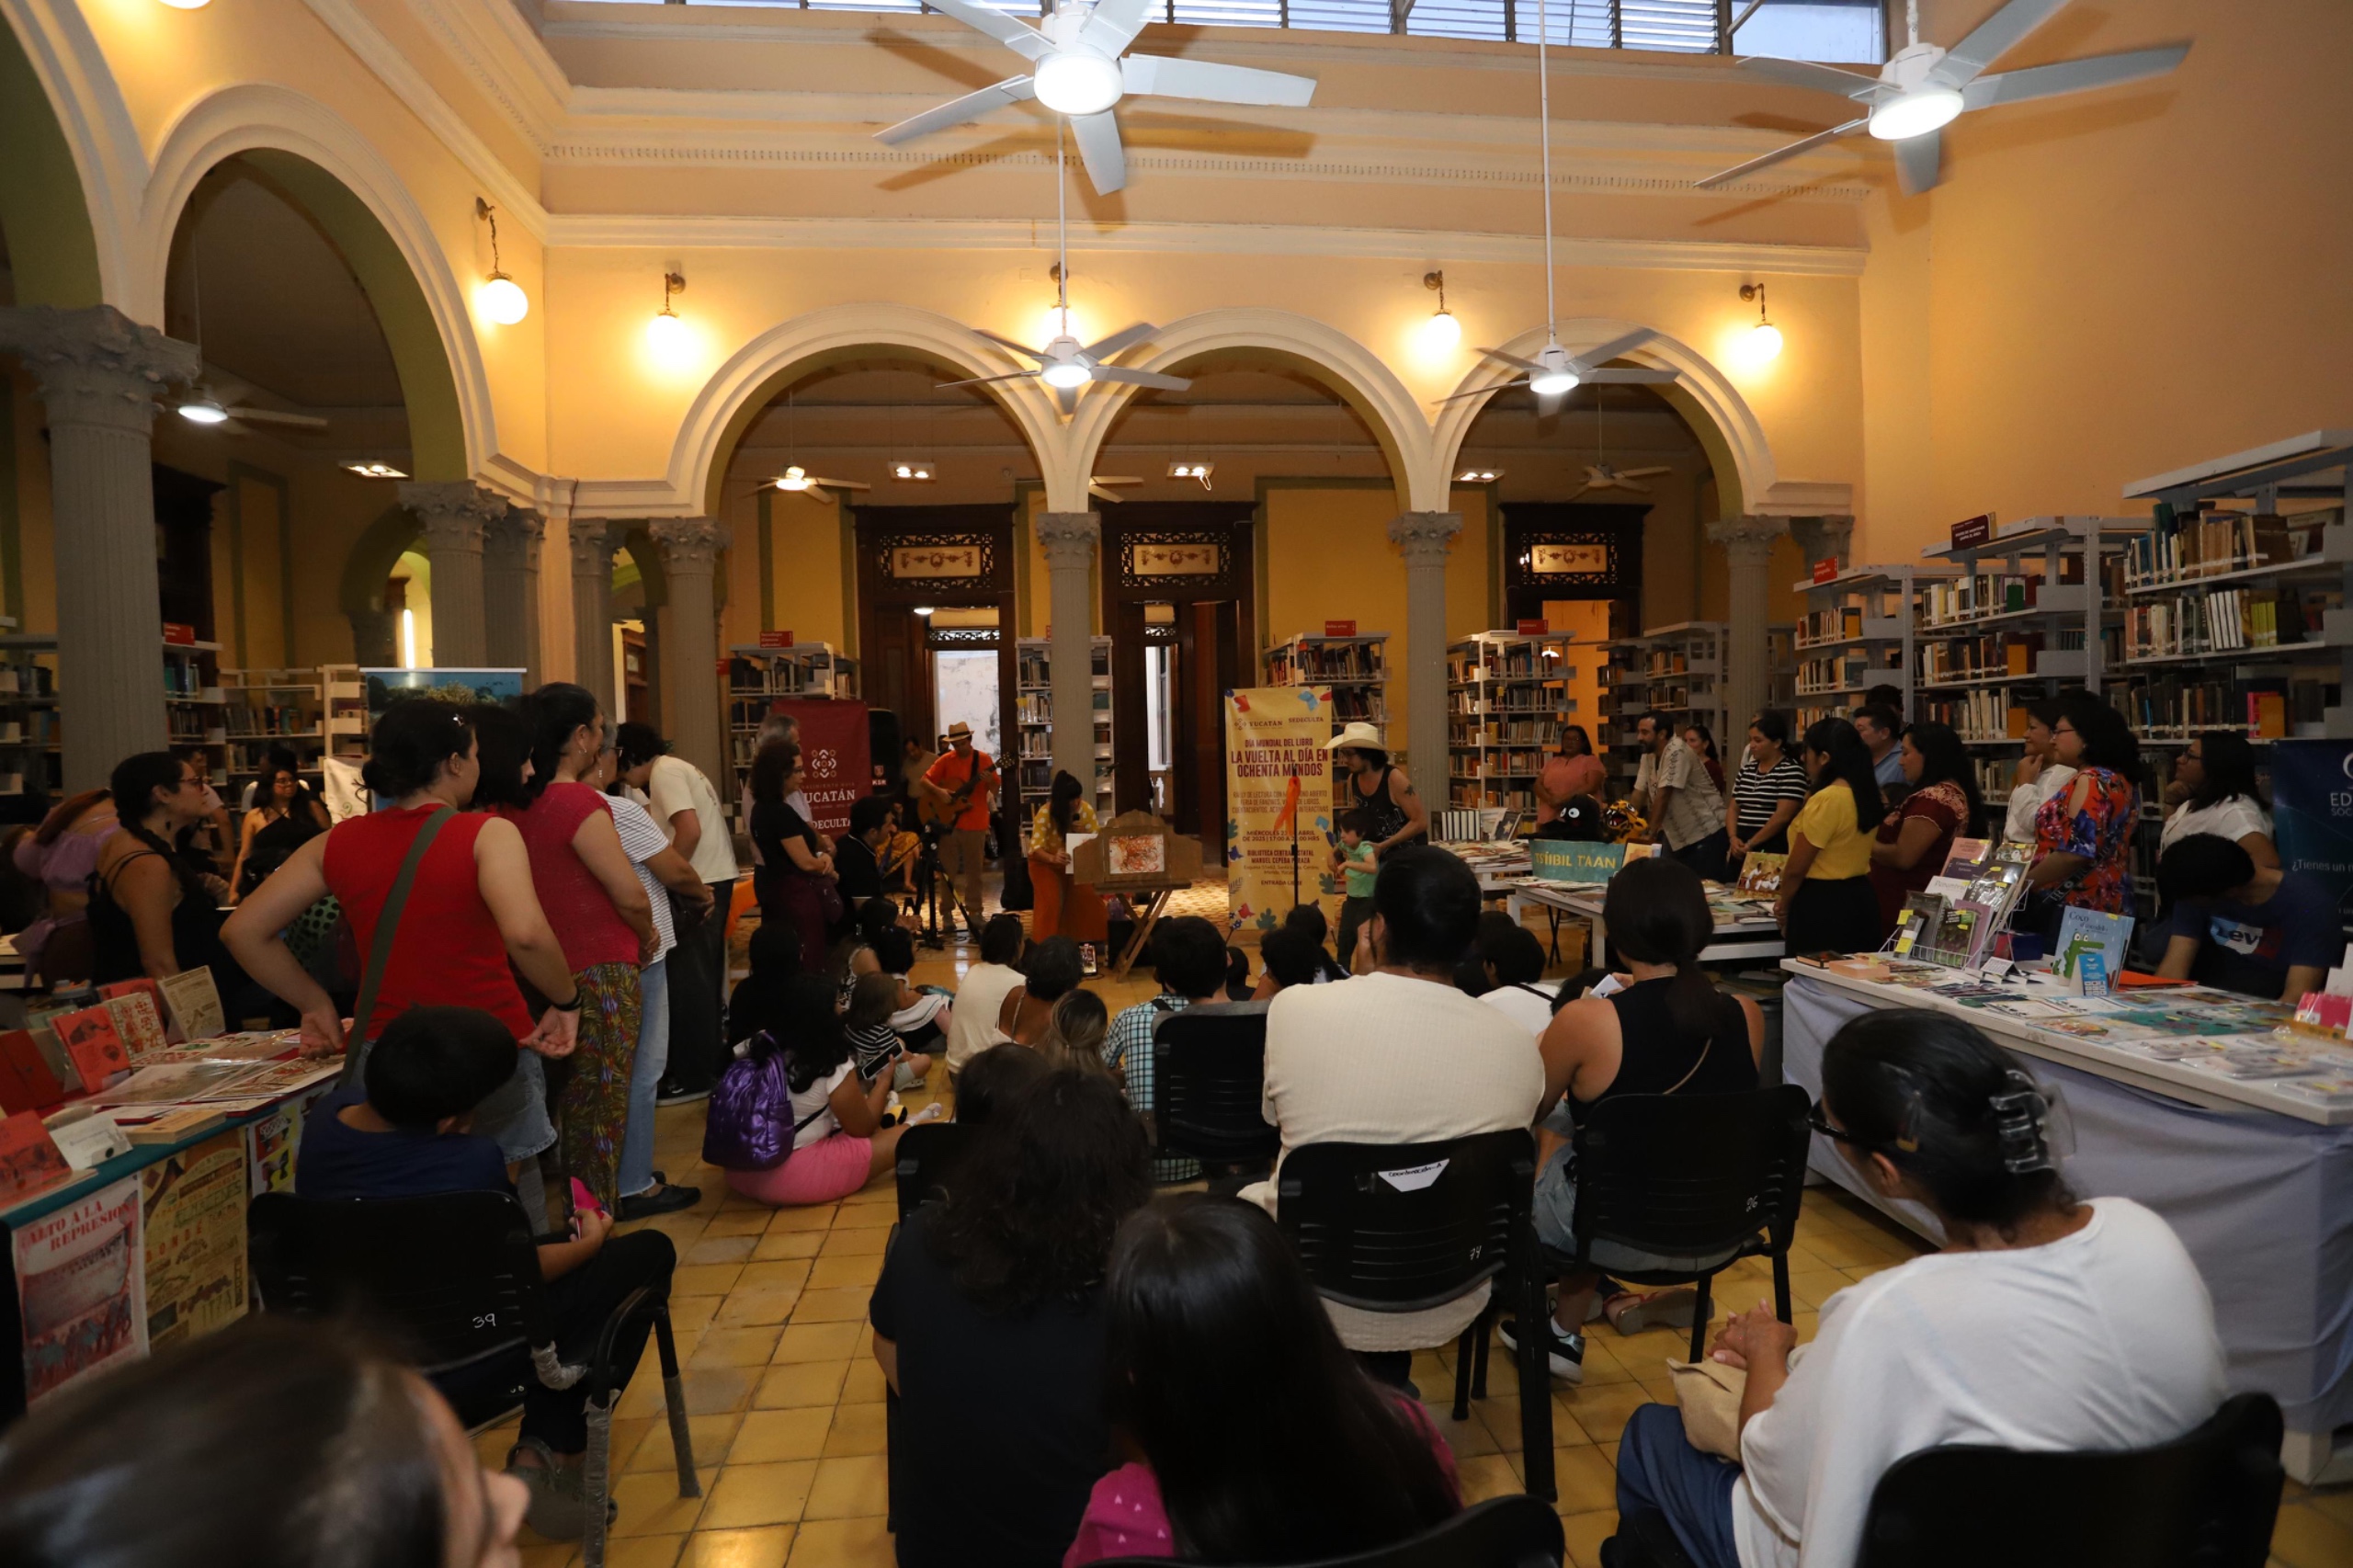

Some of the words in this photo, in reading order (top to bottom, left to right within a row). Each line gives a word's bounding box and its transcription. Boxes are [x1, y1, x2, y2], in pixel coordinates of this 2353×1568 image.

[1256, 739, 1282, 747] MUNDIAL
[1284, 738, 1294, 746] DEL
[1296, 738, 1313, 746] LIBRO
[1232, 751, 1243, 764] LA
[1245, 749, 1281, 764] VUELTA
[1284, 749, 1295, 763] AL
[1298, 747, 1314, 762] DÍA
[1316, 748, 1328, 762] EN
[1237, 764, 1280, 778] OCHENTA
[802, 789, 856, 804] UCATÁN
[813, 817, 851, 830] DECULT
[2291, 858, 2330, 872] ¿Tienes
[2333, 864, 2346, 872] un
[29, 1218, 66, 1244] ALTO
[71, 1211, 80, 1223] A
[85, 1200, 102, 1218] LA
[472, 1312, 496, 1329] 39
